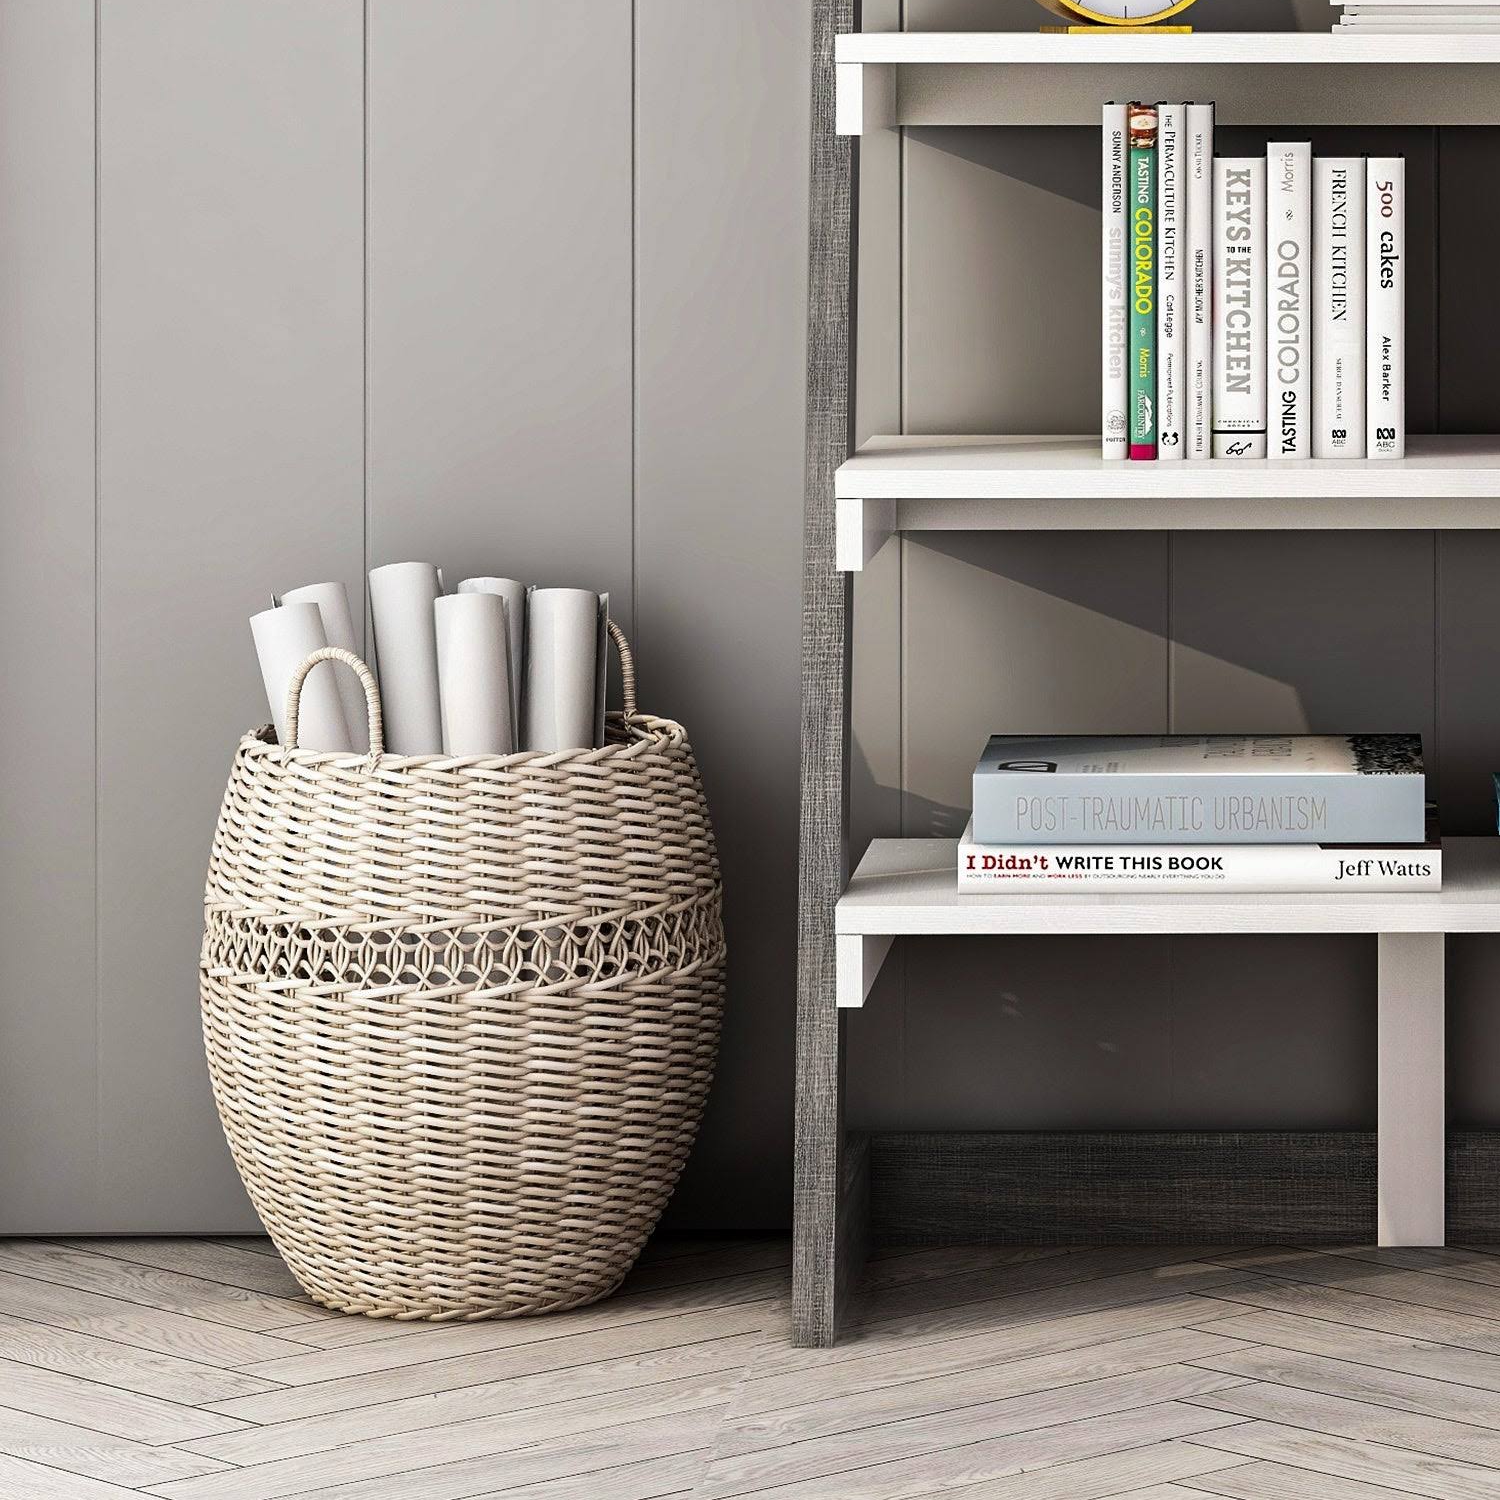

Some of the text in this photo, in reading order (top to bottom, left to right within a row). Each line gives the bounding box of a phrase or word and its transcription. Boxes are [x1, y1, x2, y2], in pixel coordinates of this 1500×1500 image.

[1112, 130, 1122, 214] SUNNY ANDERSON
[1137, 156, 1150, 203] TASTING
[1164, 114, 1176, 281] THE PERMACULTURE KITCHEN
[1225, 168, 1251, 242] KEYS
[1135, 207, 1153, 315] COLORADO
[1226, 246, 1251, 254] TO THE
[1331, 169, 1347, 321] FRENCH KITCHEN
[1375, 180, 1400, 290] 500 cakes
[1107, 227, 1126, 380] sunny's kitchen
[1225, 257, 1251, 395] KITCHEN
[1277, 151, 1300, 454] TASTING COLORADO Morris
[1381, 336, 1392, 402] Alex Barker
[1136, 389, 1146, 439] FARCOUNTRY
[1376, 441, 1396, 449] ABC
[1016, 795, 1328, 832] POST-TRAUMATIC URBANISM
[966, 854, 1223, 870] I Didn't WRITE THIS BOOK
[1334, 858, 1432, 881] Jeff Watts
